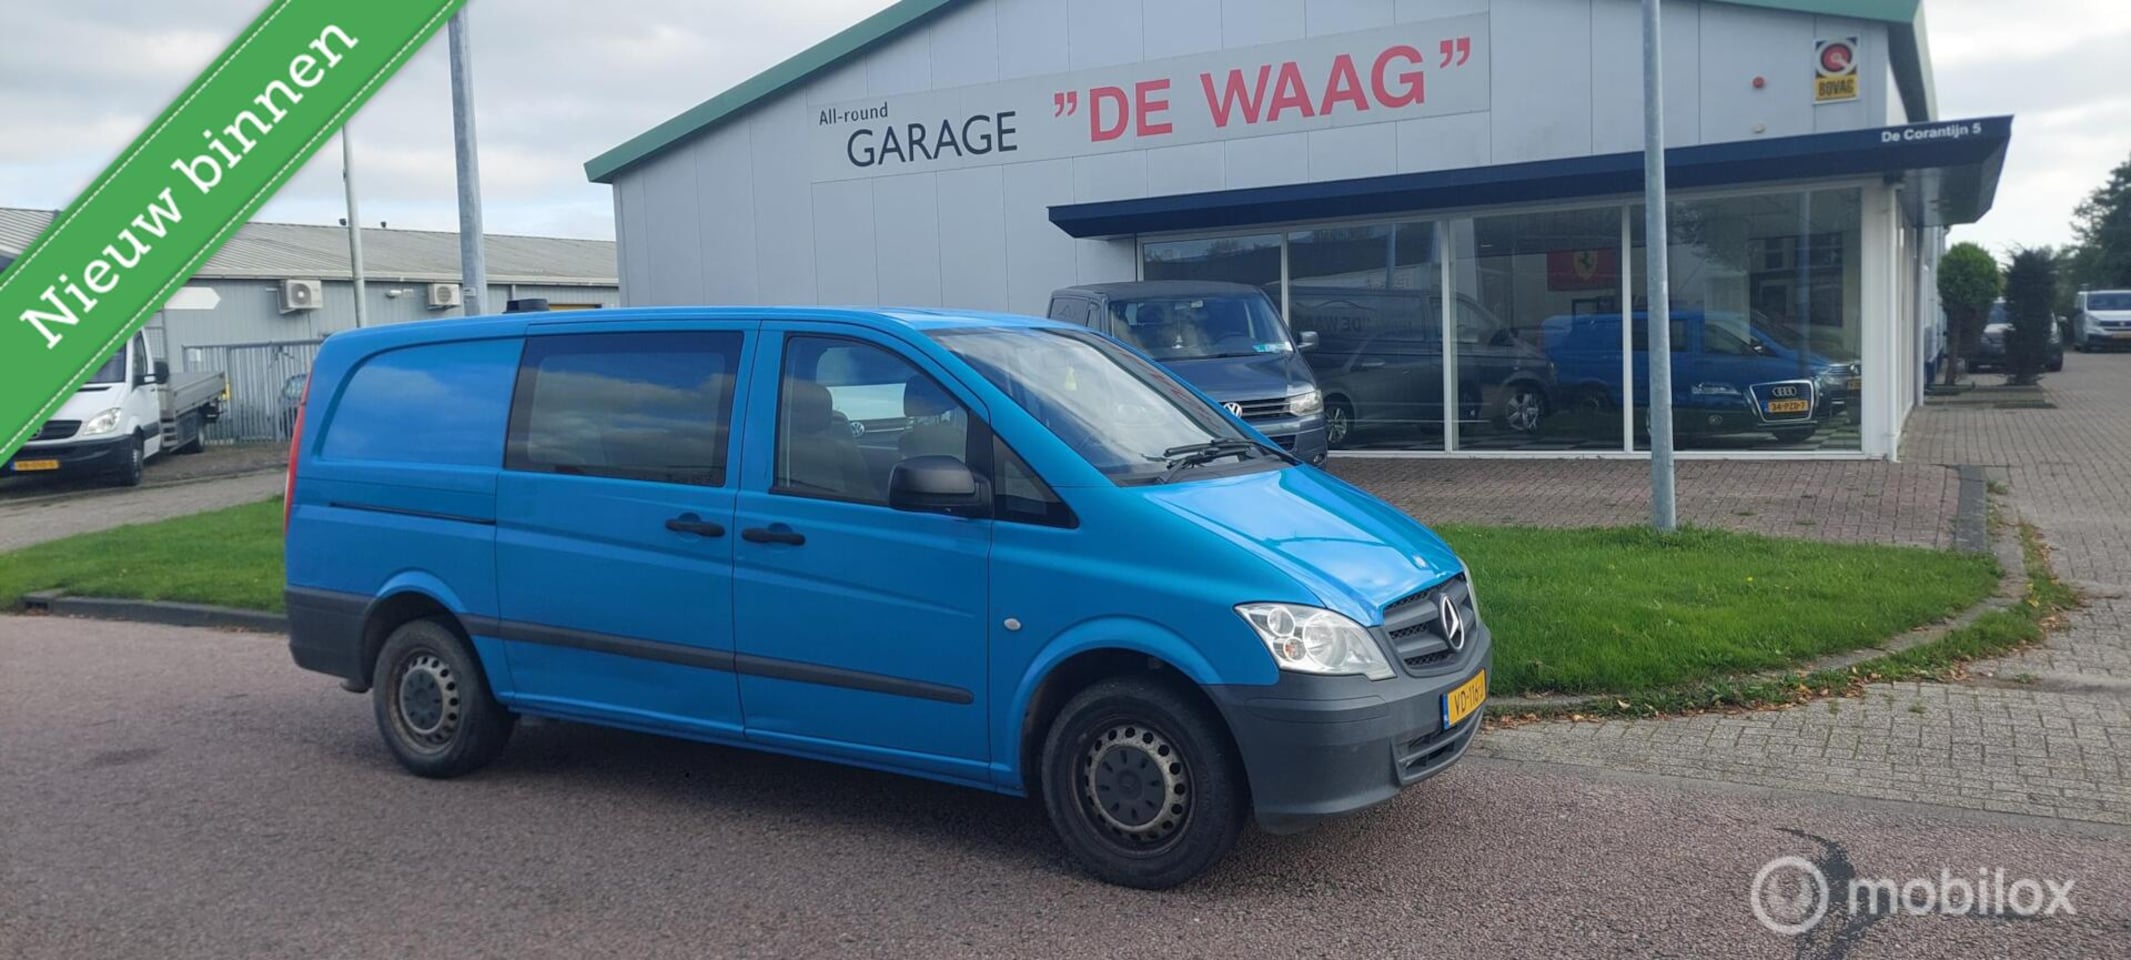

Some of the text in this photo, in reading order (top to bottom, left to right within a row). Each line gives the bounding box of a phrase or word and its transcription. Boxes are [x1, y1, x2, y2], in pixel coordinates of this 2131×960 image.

[1818, 78, 1855, 97] BOVAG
[818, 101, 888, 126] All-round
[846, 111, 1018, 168] GARAGE
[1881, 123, 1982, 142] De Corantijn 5
